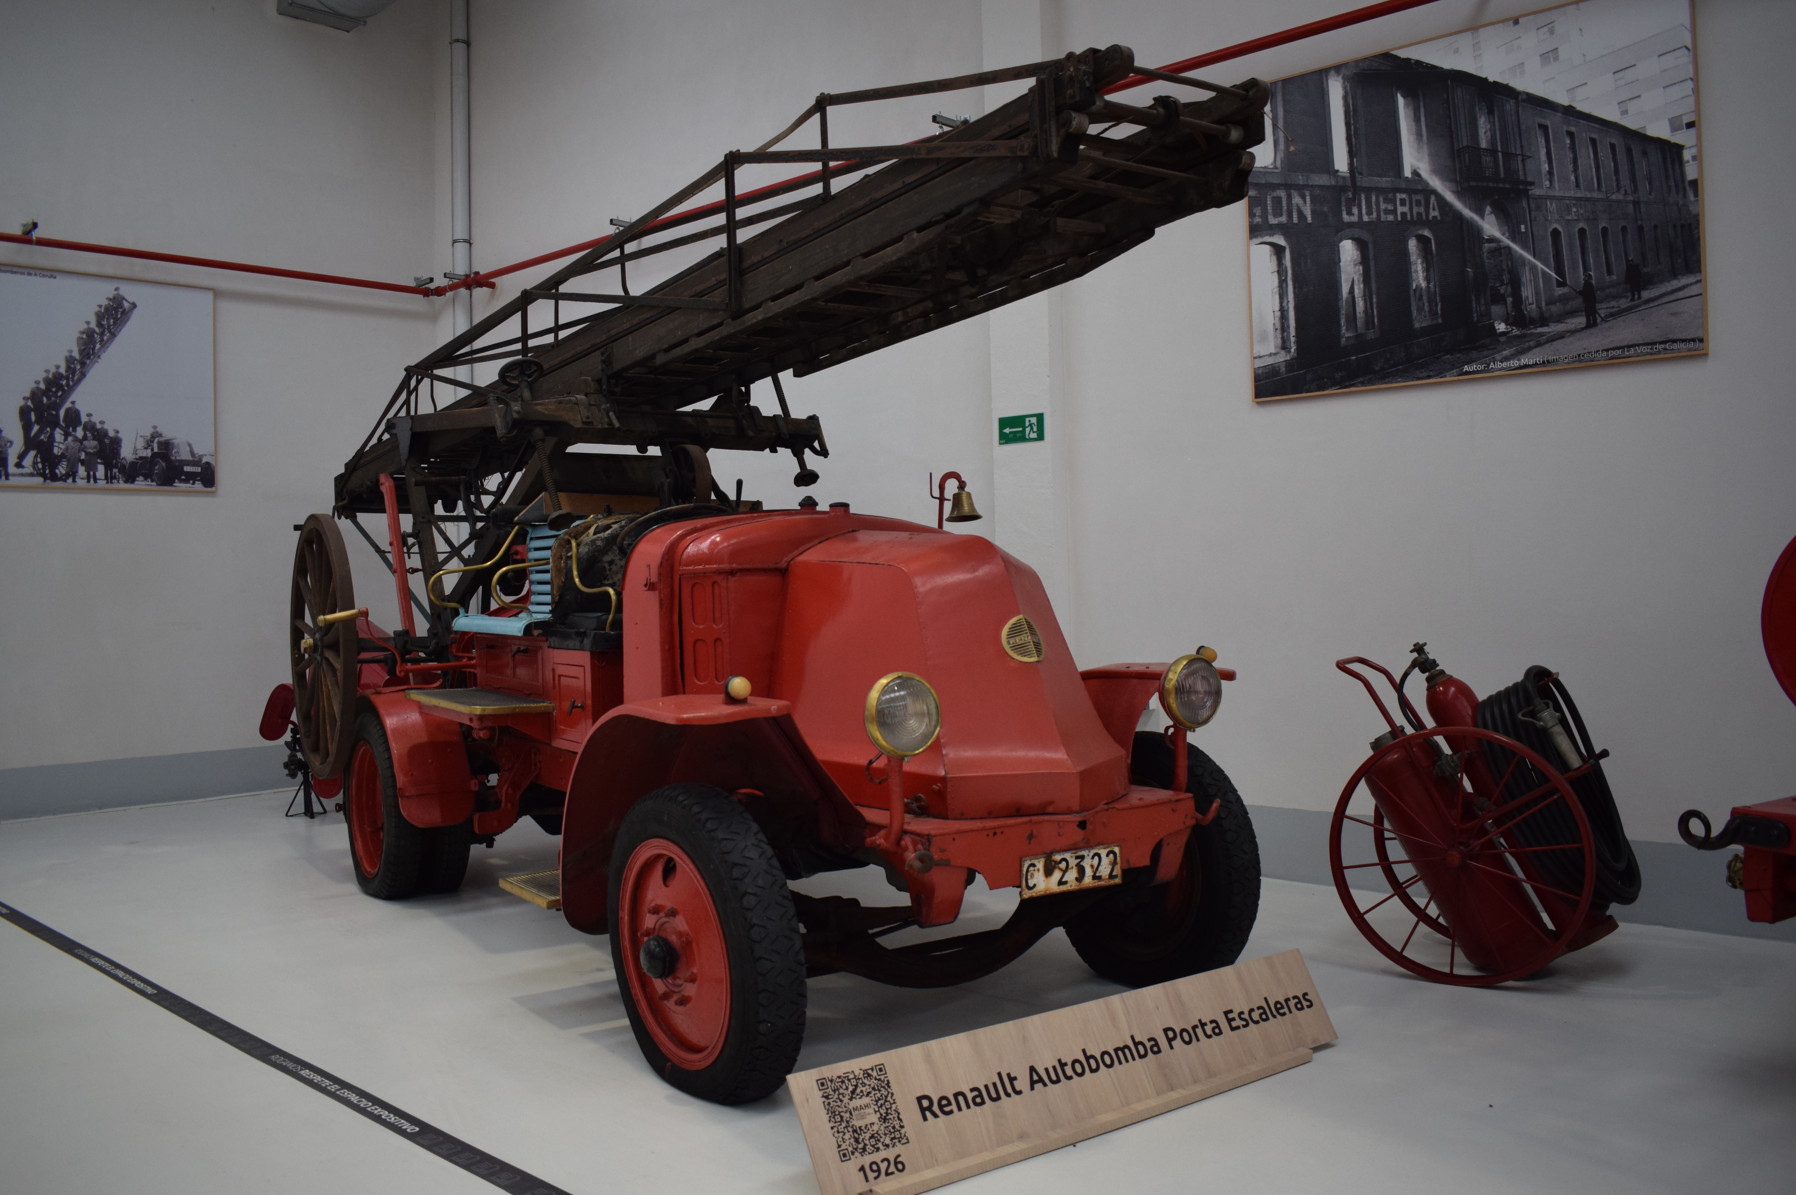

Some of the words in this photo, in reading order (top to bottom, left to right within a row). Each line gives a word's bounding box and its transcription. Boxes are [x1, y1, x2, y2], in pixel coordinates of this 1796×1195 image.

[1341, 191, 1441, 222] GUERRA
[1463, 364, 1488, 373] Autor:
[1489, 358, 1519, 370] Alberto
[1549, 353, 1578, 364] imagen
[1580, 347, 1607, 360] cedida
[1608, 347, 1622, 358] por
[1624, 345, 1635, 355] La
[1636, 344, 1651, 354] Voz
[1652, 342, 1665, 352] de
[1666, 339, 1694, 350] Galicia
[1024, 862, 1038, 892] C
[1056, 849, 1120, 888] 2322
[915, 1071, 1024, 1123] Renault
[1028, 1034, 1163, 1092] Autobomba
[1162, 1018, 1224, 1050] Porta
[1222, 990, 1315, 1032] Escaleras
[299, 1069, 331, 1088] RESPETE
[327, 1083, 342, 1093] EL
[337, 1089, 373, 1108] ESPACIO
[367, 1105, 420, 1133] EXPOSITIVO
[852, 1102, 872, 1113] MAHI
[858, 1153, 907, 1184] 1926
